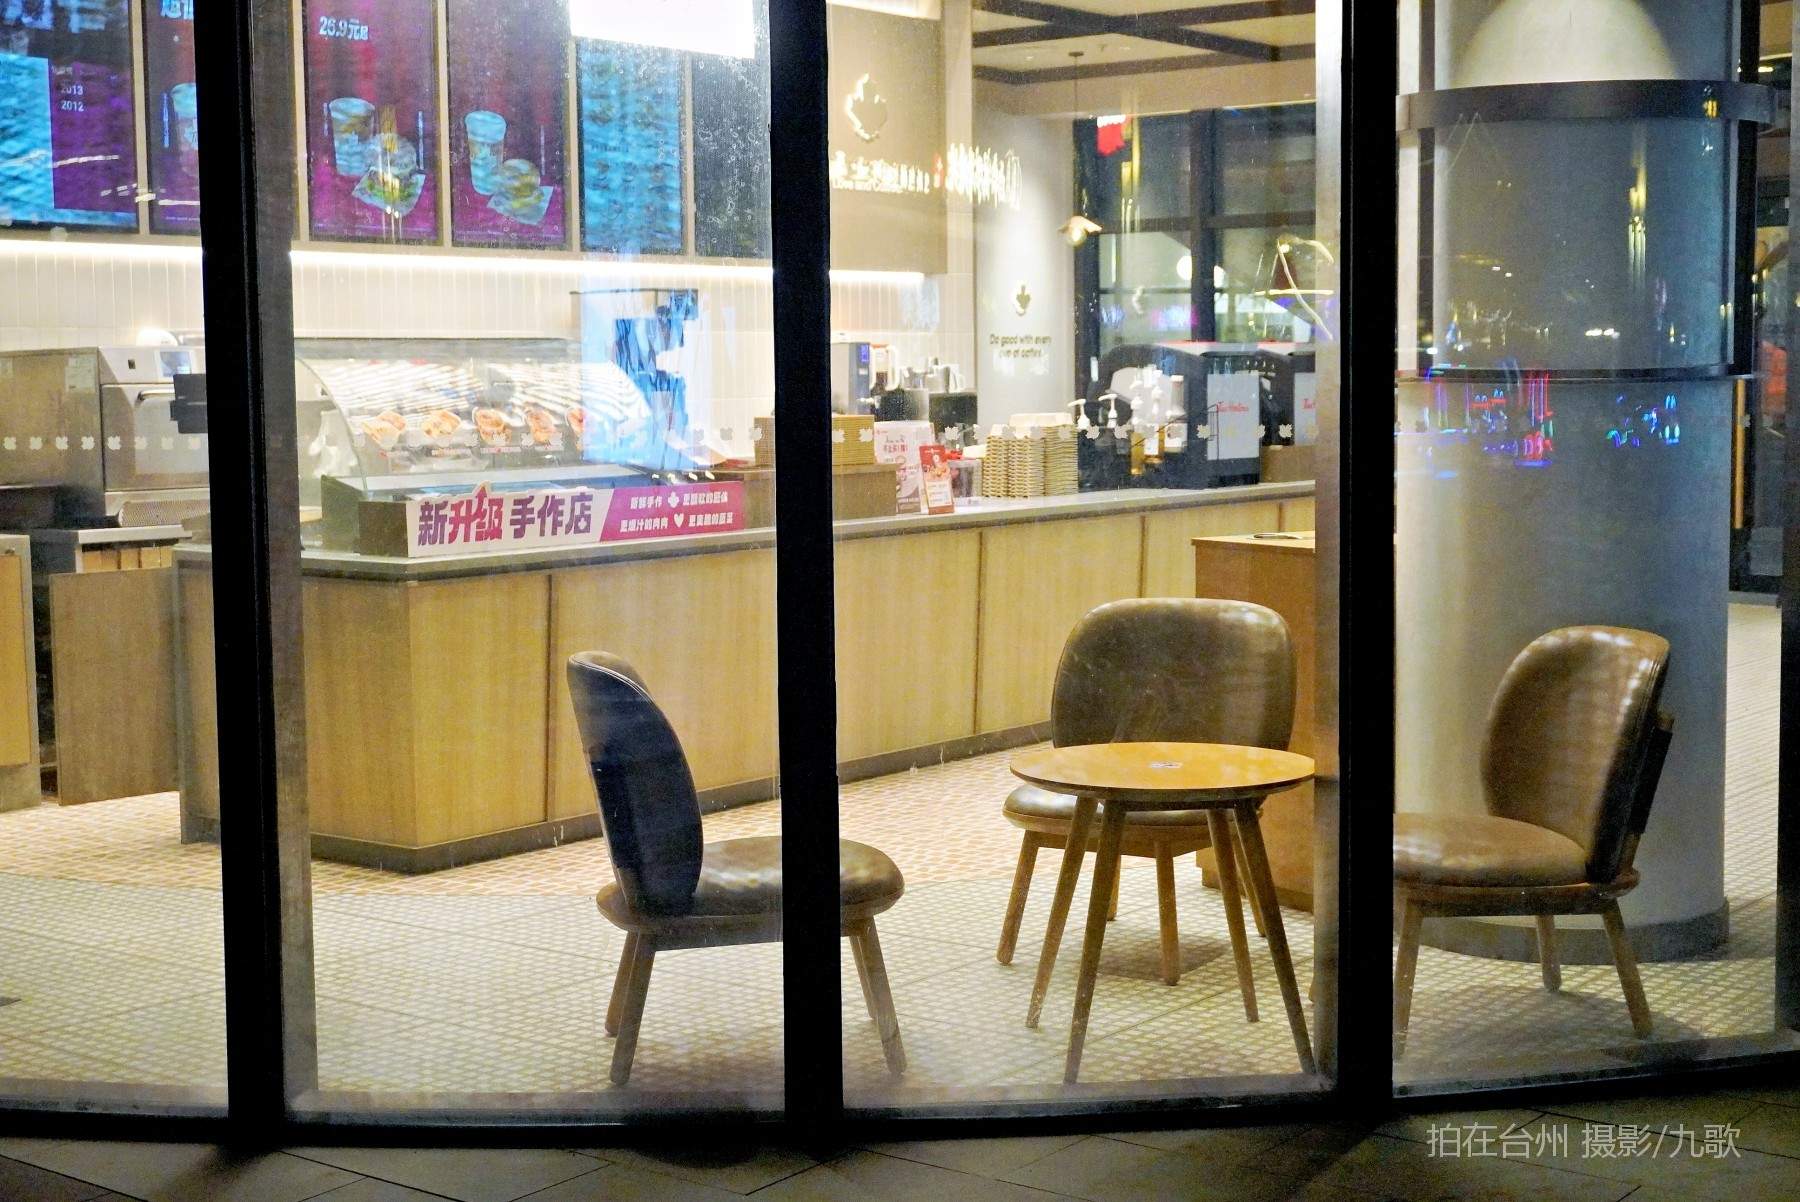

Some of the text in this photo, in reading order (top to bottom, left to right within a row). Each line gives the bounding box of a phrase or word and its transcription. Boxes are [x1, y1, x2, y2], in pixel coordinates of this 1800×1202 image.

[61, 100, 85, 112] 2012
[417, 487, 594, 546] 新升级 手作店
